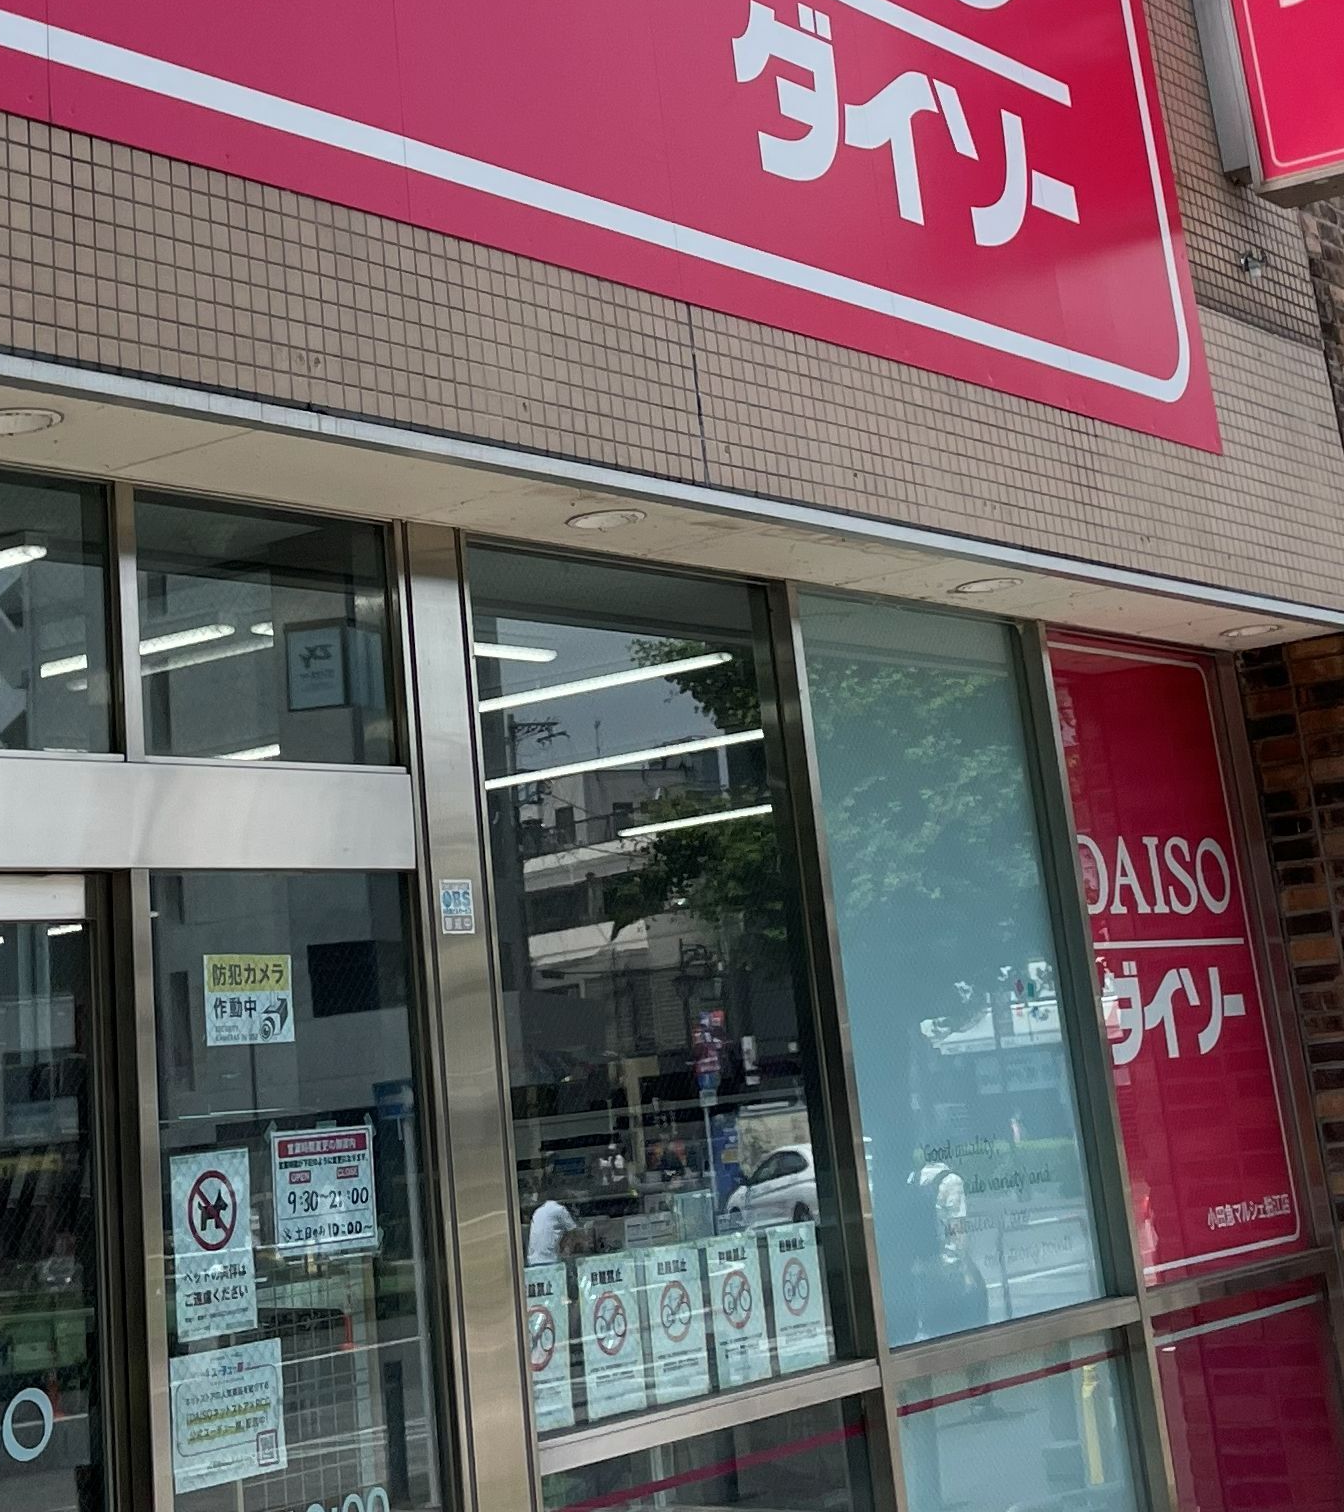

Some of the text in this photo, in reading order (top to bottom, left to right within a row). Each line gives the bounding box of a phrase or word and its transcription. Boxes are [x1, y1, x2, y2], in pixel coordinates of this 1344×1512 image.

[732, 0, 1080, 247] ダイソー
[1077, 834, 1232, 915] DAISO
[211, 963, 284, 987] 防犯カメラ
[213, 996, 257, 1019] 作動中
[184, 1285, 249, 1308] ご遠慮ください
